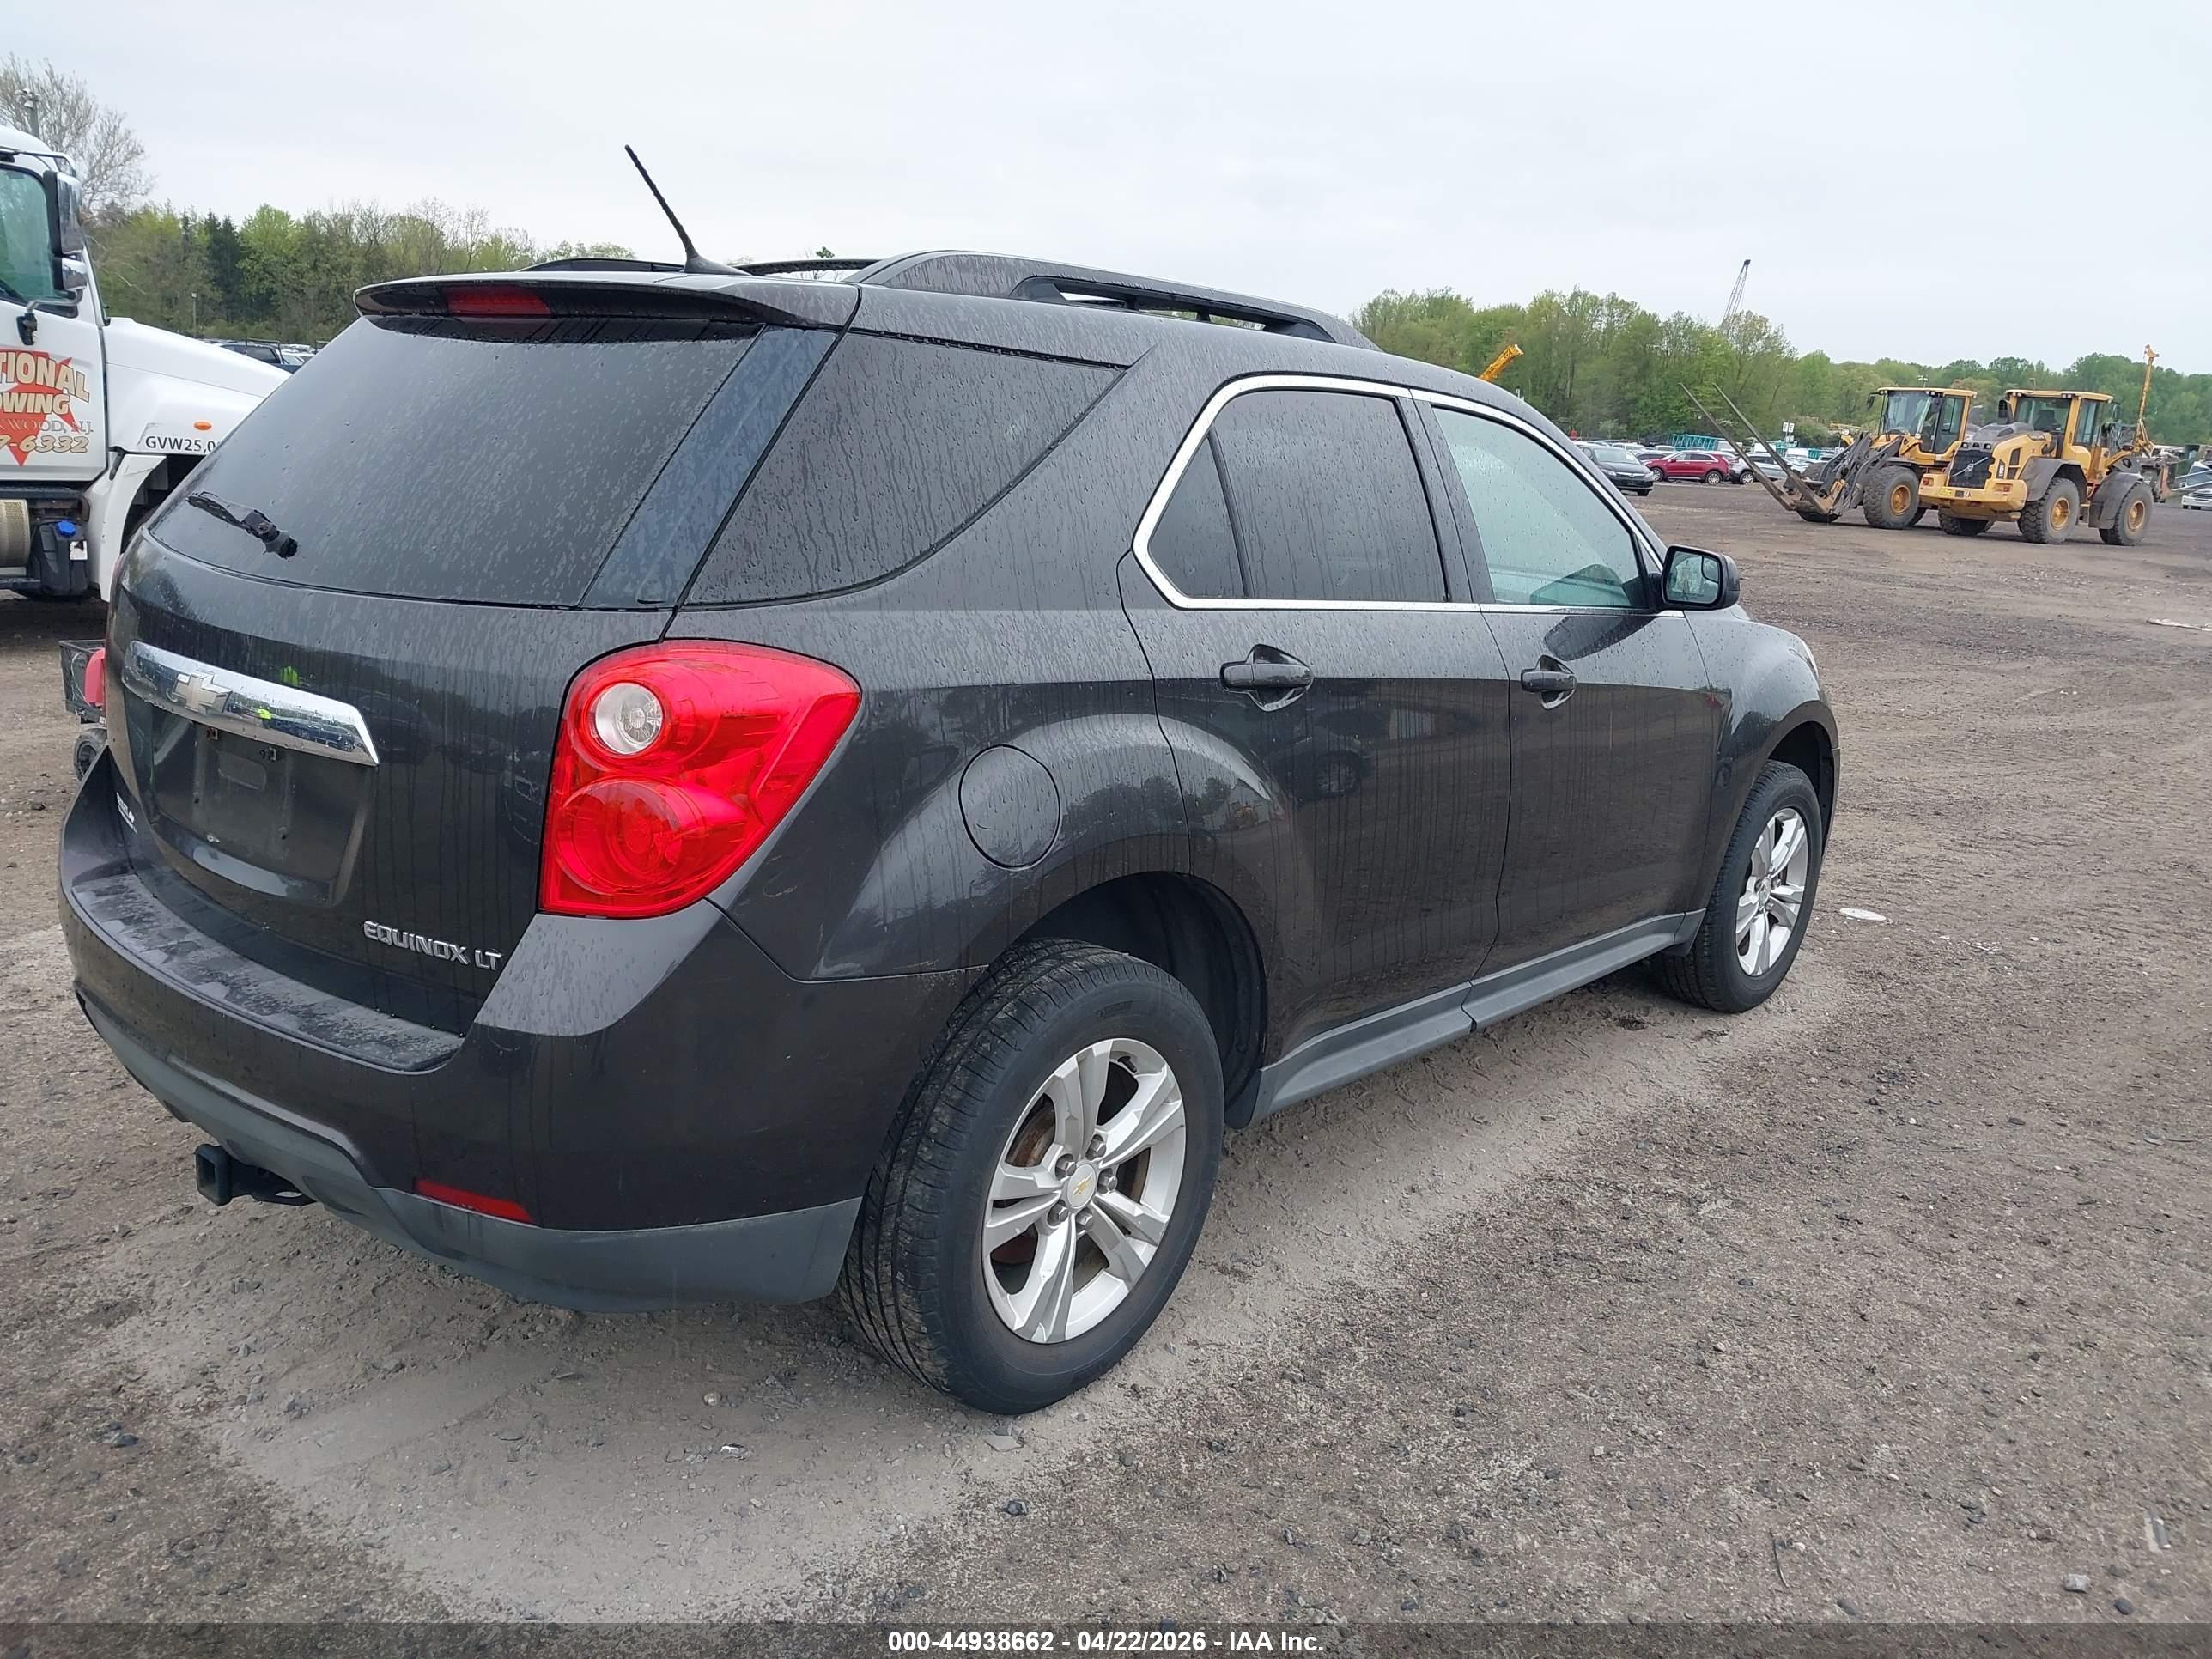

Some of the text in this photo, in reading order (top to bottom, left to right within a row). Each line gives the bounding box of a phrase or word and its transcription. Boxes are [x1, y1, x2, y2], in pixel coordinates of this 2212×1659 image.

[0, 392, 70, 416] WING
[145, 435, 219, 454] GVW25,0
[363, 921, 502, 971] EQUINOX LT
